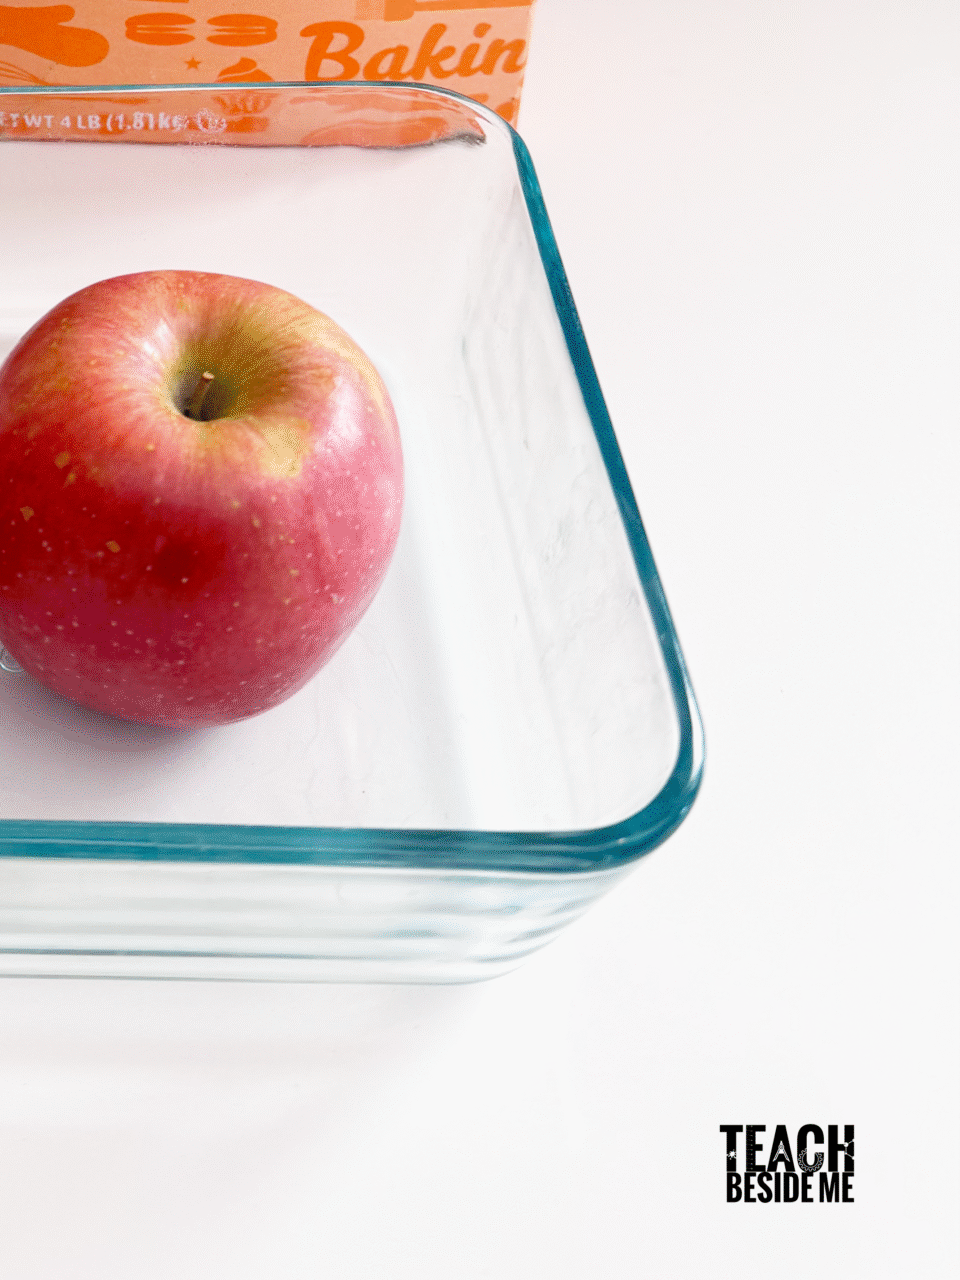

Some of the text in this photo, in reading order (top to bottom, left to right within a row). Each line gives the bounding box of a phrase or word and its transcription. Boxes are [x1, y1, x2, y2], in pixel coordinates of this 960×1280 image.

[299, 21, 527, 81] Bakin
[24, 114, 55, 128] WT
[59, 115, 71, 128] 4
[77, 115, 101, 129] LB
